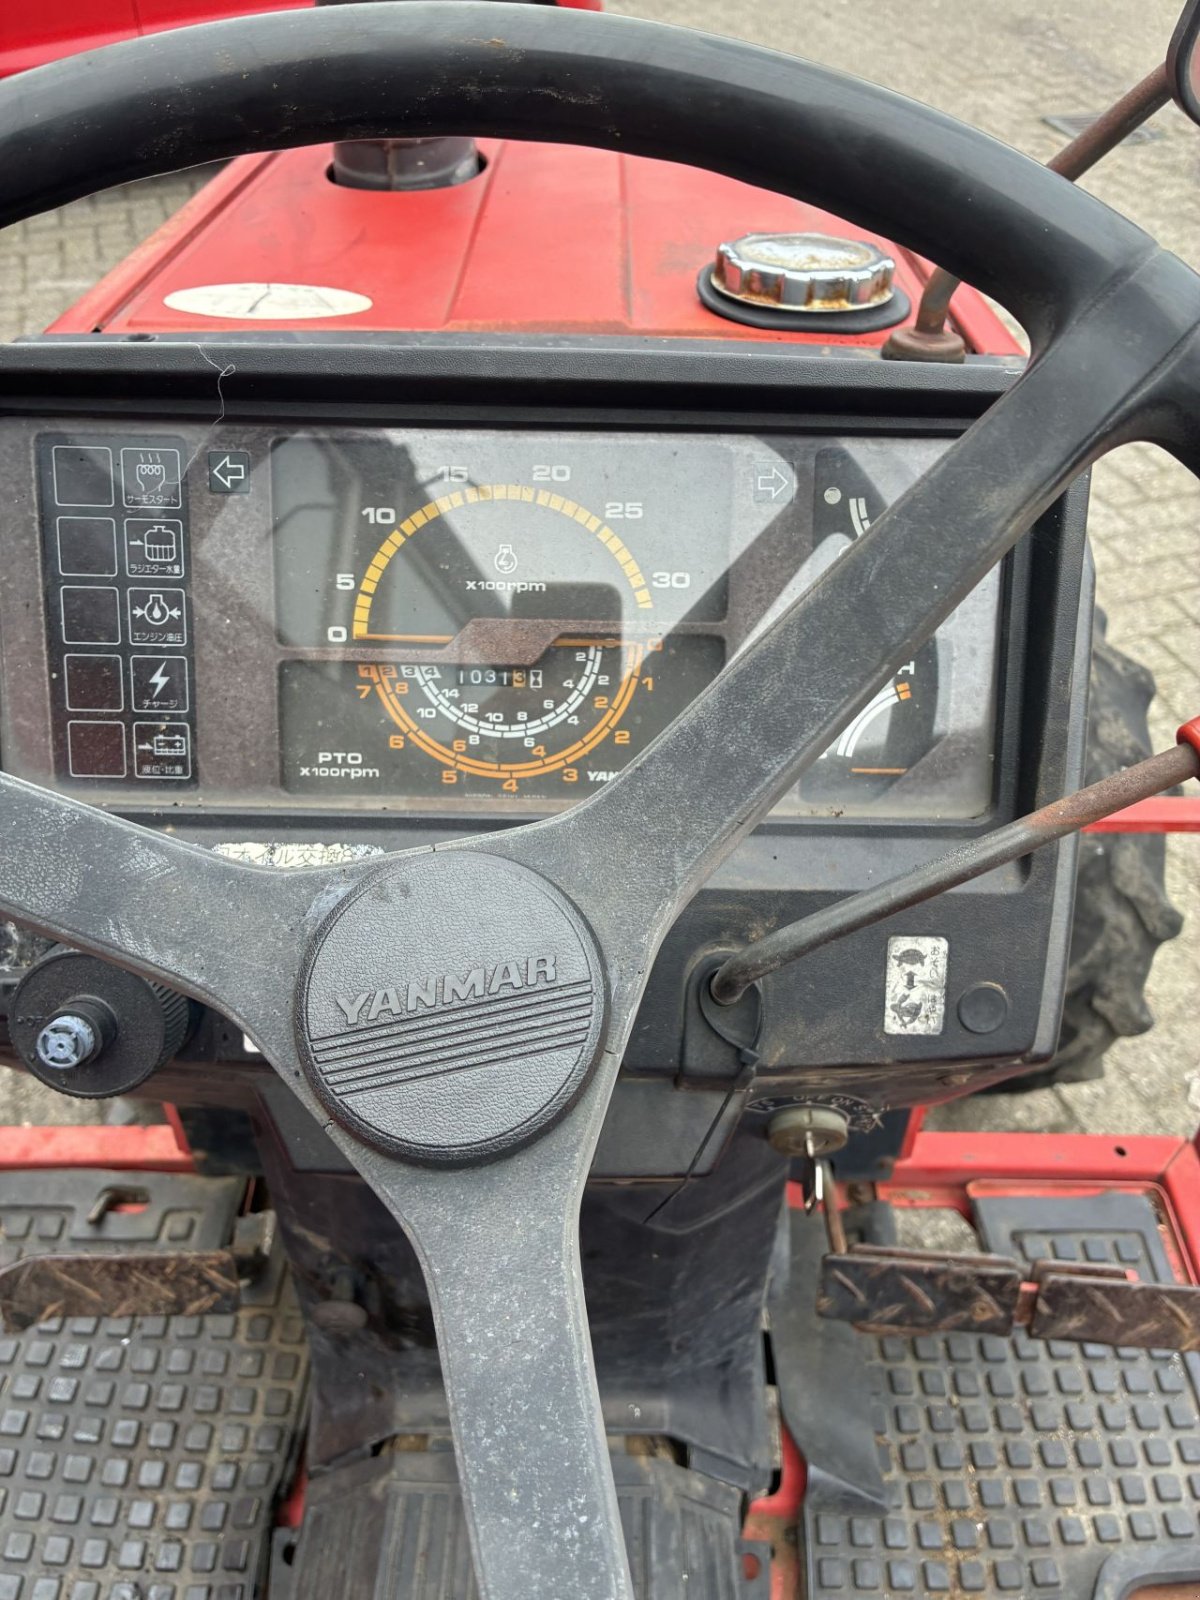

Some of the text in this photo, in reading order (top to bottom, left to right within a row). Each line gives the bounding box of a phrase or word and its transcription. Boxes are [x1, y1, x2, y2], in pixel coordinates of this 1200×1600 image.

[437, 466, 468, 483] 15
[532, 465, 571, 482] 20
[362, 507, 396, 524] 10
[605, 502, 643, 519] 25
[336, 573, 355, 590] 5
[652, 572, 690, 589] 30
[327, 626, 347, 643] 0
[575, 652, 586, 662] 2
[562, 679, 574, 689] 4
[597, 674, 609, 685] 2
[642, 677, 653, 691] 1
[356, 685, 371, 699] 7
[395, 682, 409, 694] 8
[442, 688, 460, 698] 14
[460, 703, 479, 713] 12
[543, 699, 554, 709] 6
[594, 696, 608, 708] 2
[416, 708, 436, 718] 10
[485, 713, 503, 722] 10
[517, 712, 528, 721] 8
[567, 715, 579, 725] 4
[389, 735, 404, 749] 6
[469, 735, 480, 745] 8
[524, 737, 535, 747] 6
[614, 730, 630, 744] 2
[453, 740, 466, 751] 6
[532, 745, 546, 758] 4
[317, 752, 363, 764] PTO
[442, 770, 457, 784] 5
[562, 768, 578, 782] 3
[502, 779, 519, 793] 4
[335, 954, 558, 1025] YANMAR
